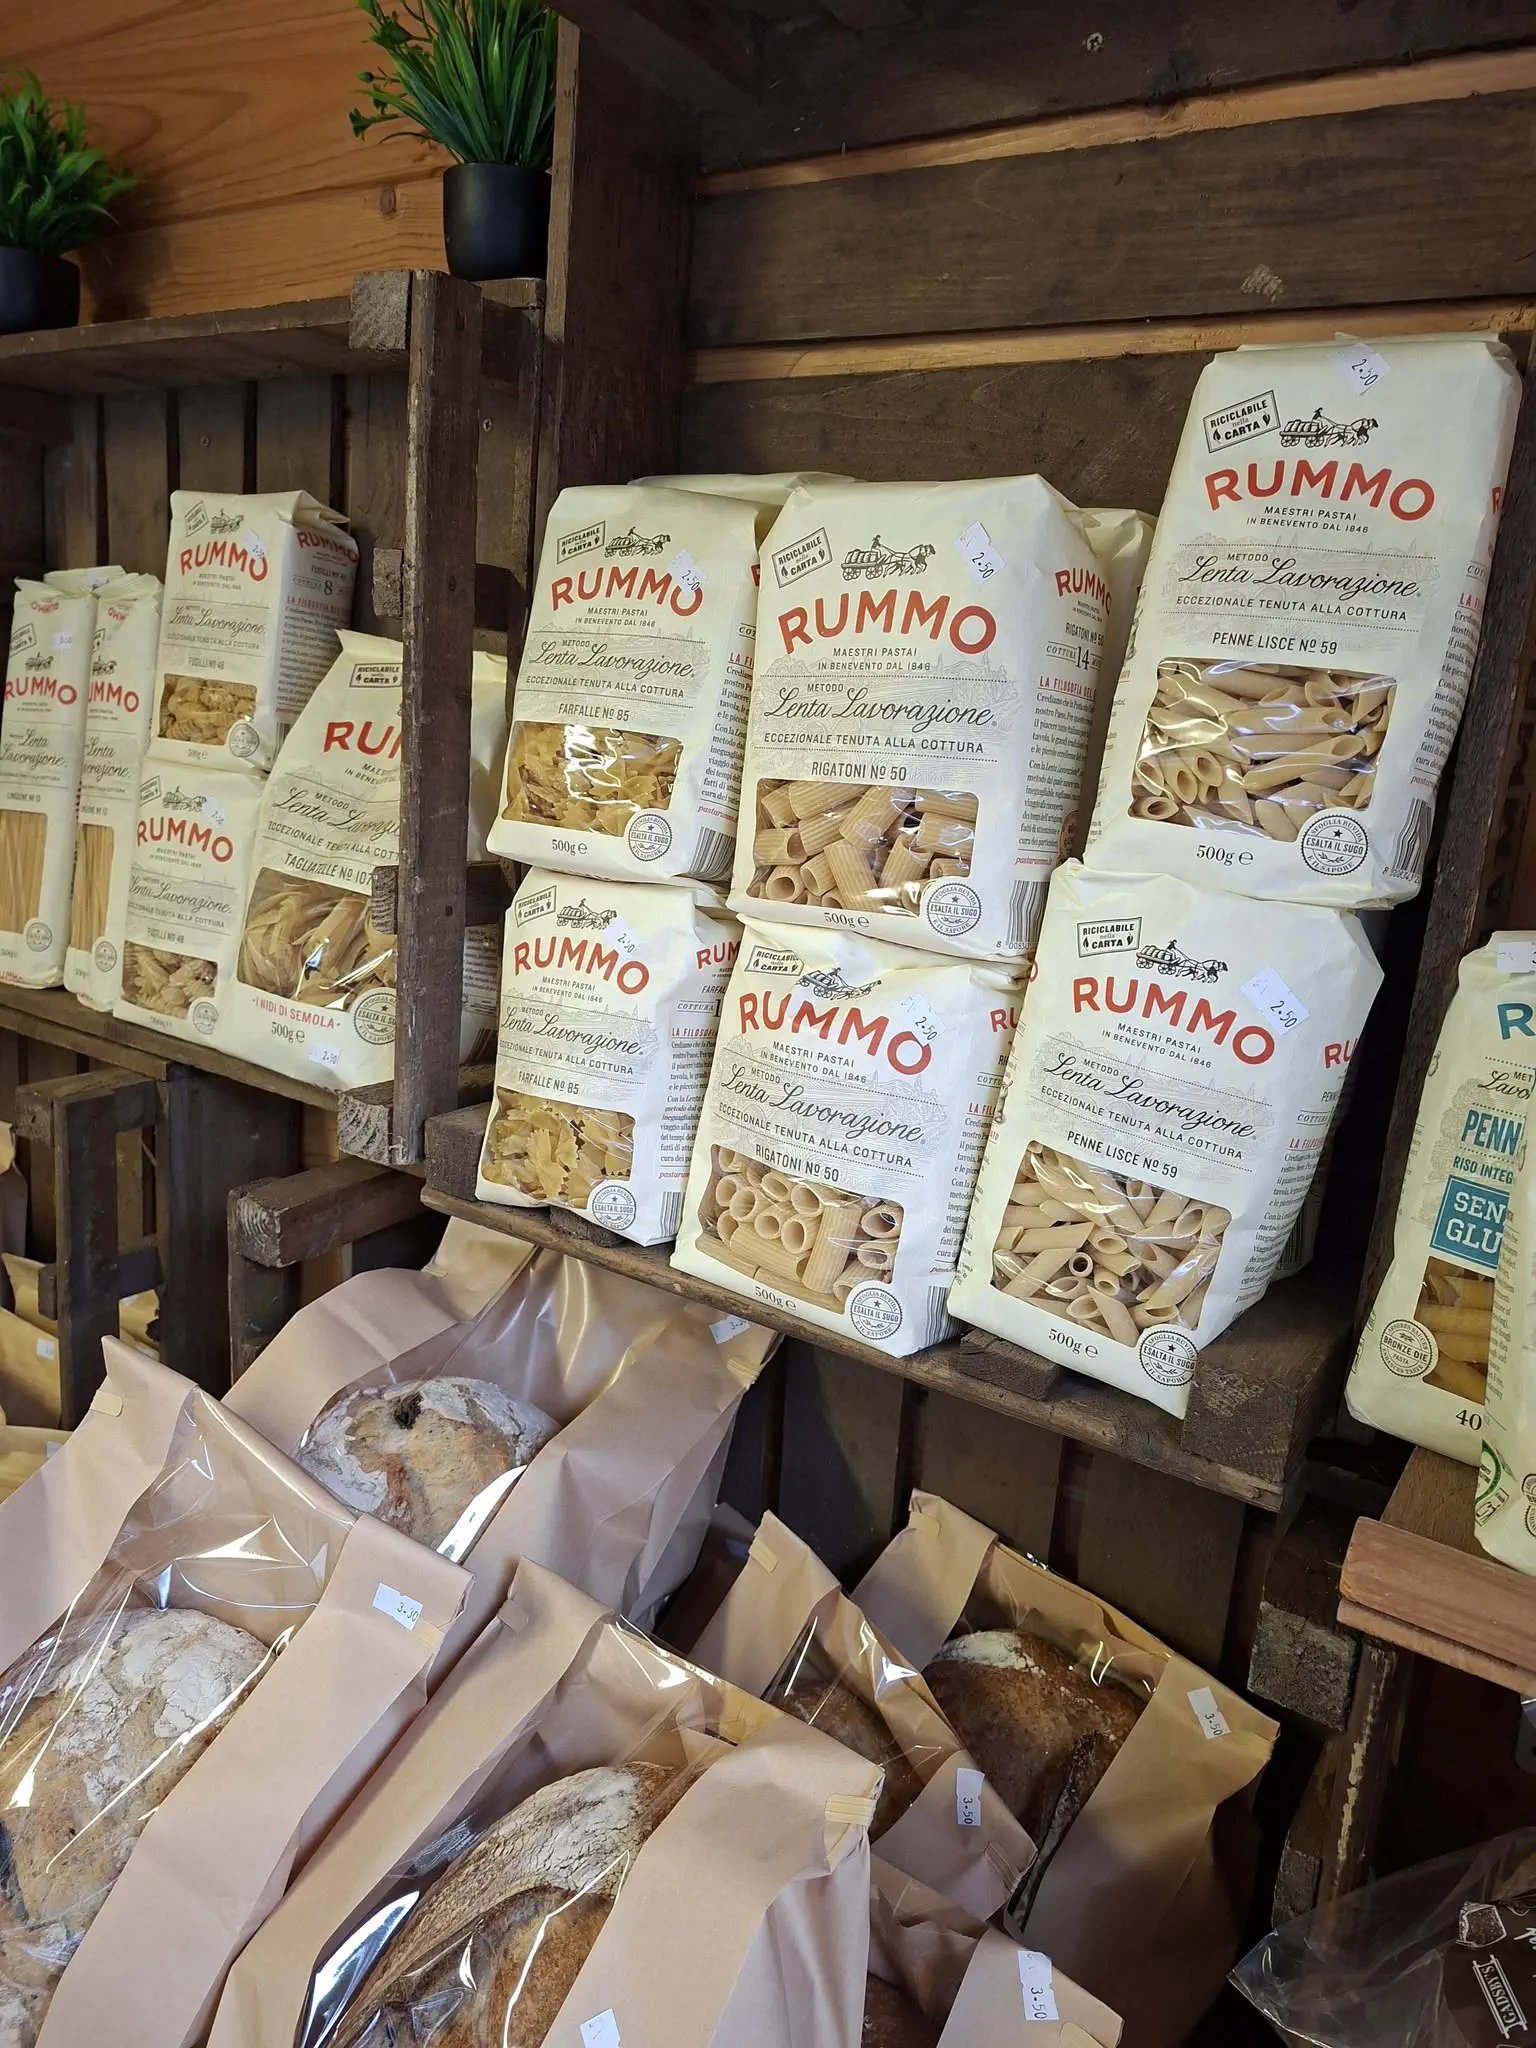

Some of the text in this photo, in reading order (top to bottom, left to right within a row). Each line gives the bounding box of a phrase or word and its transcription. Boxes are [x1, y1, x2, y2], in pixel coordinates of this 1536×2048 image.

[1210, 399, 1269, 428] RICICLABILE
[1224, 421, 1261, 441] CARTA
[1204, 459, 1435, 522] RUMMO
[1259, 518, 1369, 534] BENEVENTO DAL 1846
[1264, 506, 1357, 521] MAESTRI PASTAI
[296, 532, 358, 563] RUMMO
[561, 527, 601, 548] RICICLABILE
[567, 541, 592, 555] CARTA
[778, 536, 822, 566] RICICLABILE
[180, 540, 269, 582] RUMMO
[790, 558, 818, 577] CARTA
[971, 552, 995, 579] 2.50
[1178, 556, 1253, 583] Lenta
[1227, 552, 1268, 562] METODO
[551, 565, 703, 617] RUMMO
[681, 570, 700, 591] 2.50
[1055, 567, 1113, 617] RUMMO
[1176, 595, 1407, 621] ECCEZIONALE TENUTA ALLA COTTURA
[778, 589, 997, 655] RUMMO
[529, 641, 579, 667] Lenta
[833, 647, 917, 657] MAESTRI PASTAI
[1213, 631, 1338, 655] PENNE LISCE 59
[830, 662, 931, 671] BENEVENTO DAL 1846
[4, 676, 77, 705] RUMMO
[526, 675, 685, 699] ECCEZIONALE TENUTA ALLA COTTURA
[807, 683, 844, 692] METODO
[558, 703, 630, 722] FARFALLE 85
[764, 687, 831, 719] Lenta
[764, 733, 984, 754] ECCEZIONALE TENUTA ALLA COTTURA
[812, 761, 907, 781] RIGATONI 50
[273, 785, 330, 822] Lenta
[137, 816, 233, 863] RUMMO
[551, 838, 576, 856] 500g
[1306, 837, 1364, 855] ESALTA SUGO
[1196, 844, 1236, 867] 500g
[517, 891, 552, 909] RICICLABILE
[931, 904, 978, 917] ESALTA SUGO
[823, 911, 854, 929] 500g
[1083, 923, 1135, 935] RICICLABILE
[696, 940, 741, 970] RUM
[1091, 938, 1123, 950] CARTA
[514, 936, 649, 994] RUMMO
[760, 964, 788, 973] CARTA
[260, 999, 334, 1029] NIDI DI SEMOLA
[501, 1005, 534, 1033] Lenta
[1073, 976, 1275, 1065] RUMMO
[1270, 1000, 1298, 1028] 2.50
[271, 1021, 294, 1043] 500g
[739, 991, 932, 1076] RUMMO
[915, 1016, 938, 1041] 2.50
[1117, 1022, 1201, 1054] MAESTRI PASTAI
[535, 1047, 633, 1075] TENUTA ALLA COTTURA
[772, 1041, 855, 1068] MAESTRI PASTAI
[1113, 1033, 1212, 1069] BENEVENTO DAL 1846
[518, 1071, 552, 1089] FARFALLE
[751, 1067, 780, 1084] METODO
[769, 1054, 868, 1083] BENEVENTO DAL 1846
[1043, 1052, 1105, 1092] Lenta
[1083, 1058, 1120, 1077] METODO
[1513, 1071, 1533, 1082] MET
[721, 1063, 770, 1104] Lenta
[1478, 1071, 1530, 1100] Lavo
[719, 1102, 913, 1168] ECCEZIONALE TENUTA ALLA COTTURA
[1041, 1085, 1243, 1160] ECCEZIONALE TENUTA ALLA COTTURA
[1461, 1110, 1522, 1156] PENN
[755, 1144, 839, 1182] RIGATONI 50
[1067, 1130, 1179, 1178] PENNE LISCE 59
[1453, 1156, 1513, 1184] RISO INTEG
[1454, 1192, 1507, 1224] SEN
[1445, 1219, 1503, 1253] GLU
[854, 1305, 874, 1317] ESALTA
[1048, 1328, 1082, 1354] 500g
[1144, 1346, 1167, 1362] ESALTA
[1384, 1335, 1428, 1363] BRONZE DIE
[1456, 1409, 1482, 1431] 40
[1204, 1712, 1223, 1736] 3.50
[963, 1797, 973, 1825] 3.50
[1031, 1987, 1048, 2020] 3.50
[1481, 1965, 1517, 2029] GADSBY'S
